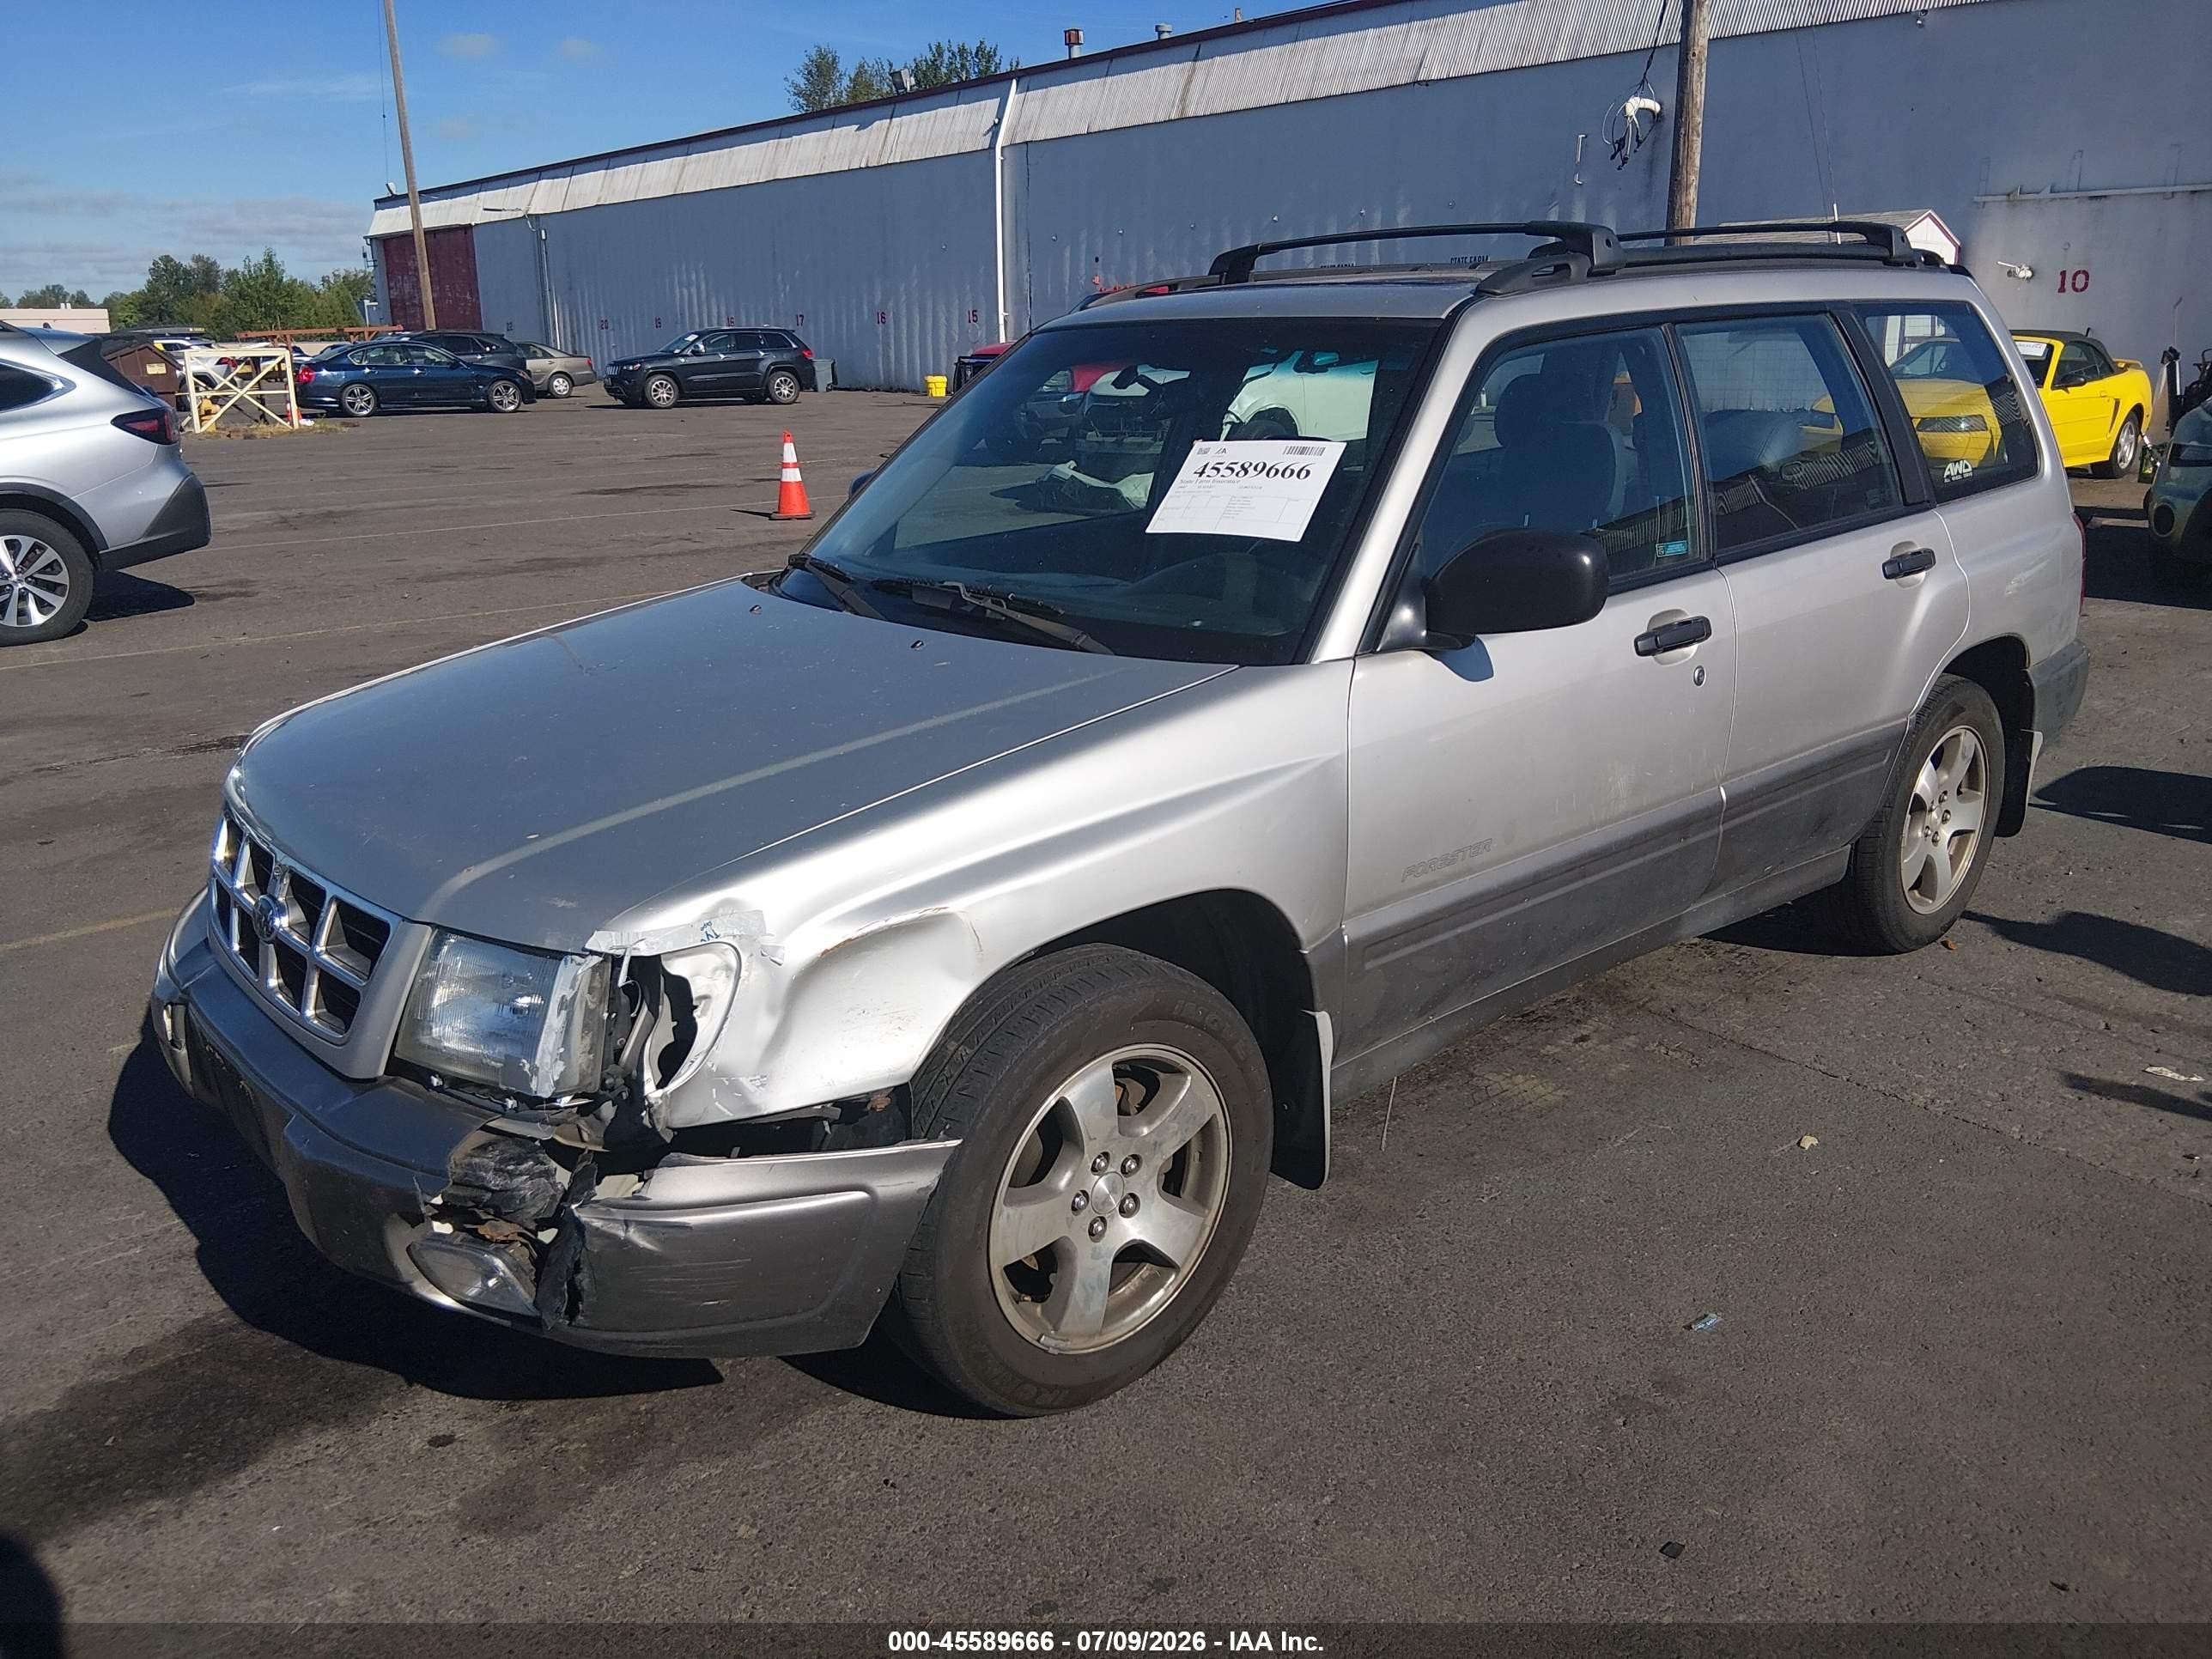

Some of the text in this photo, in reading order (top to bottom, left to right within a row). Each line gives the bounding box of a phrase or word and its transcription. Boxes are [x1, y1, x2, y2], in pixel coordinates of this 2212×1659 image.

[2057, 270, 2090, 293] 10
[796, 314, 805, 326] 17
[968, 309, 978, 323] 15
[1194, 461, 1315, 480] 45589666
[1943, 459, 1972, 477] AWD
[1401, 837, 1492, 883] FORESTER
